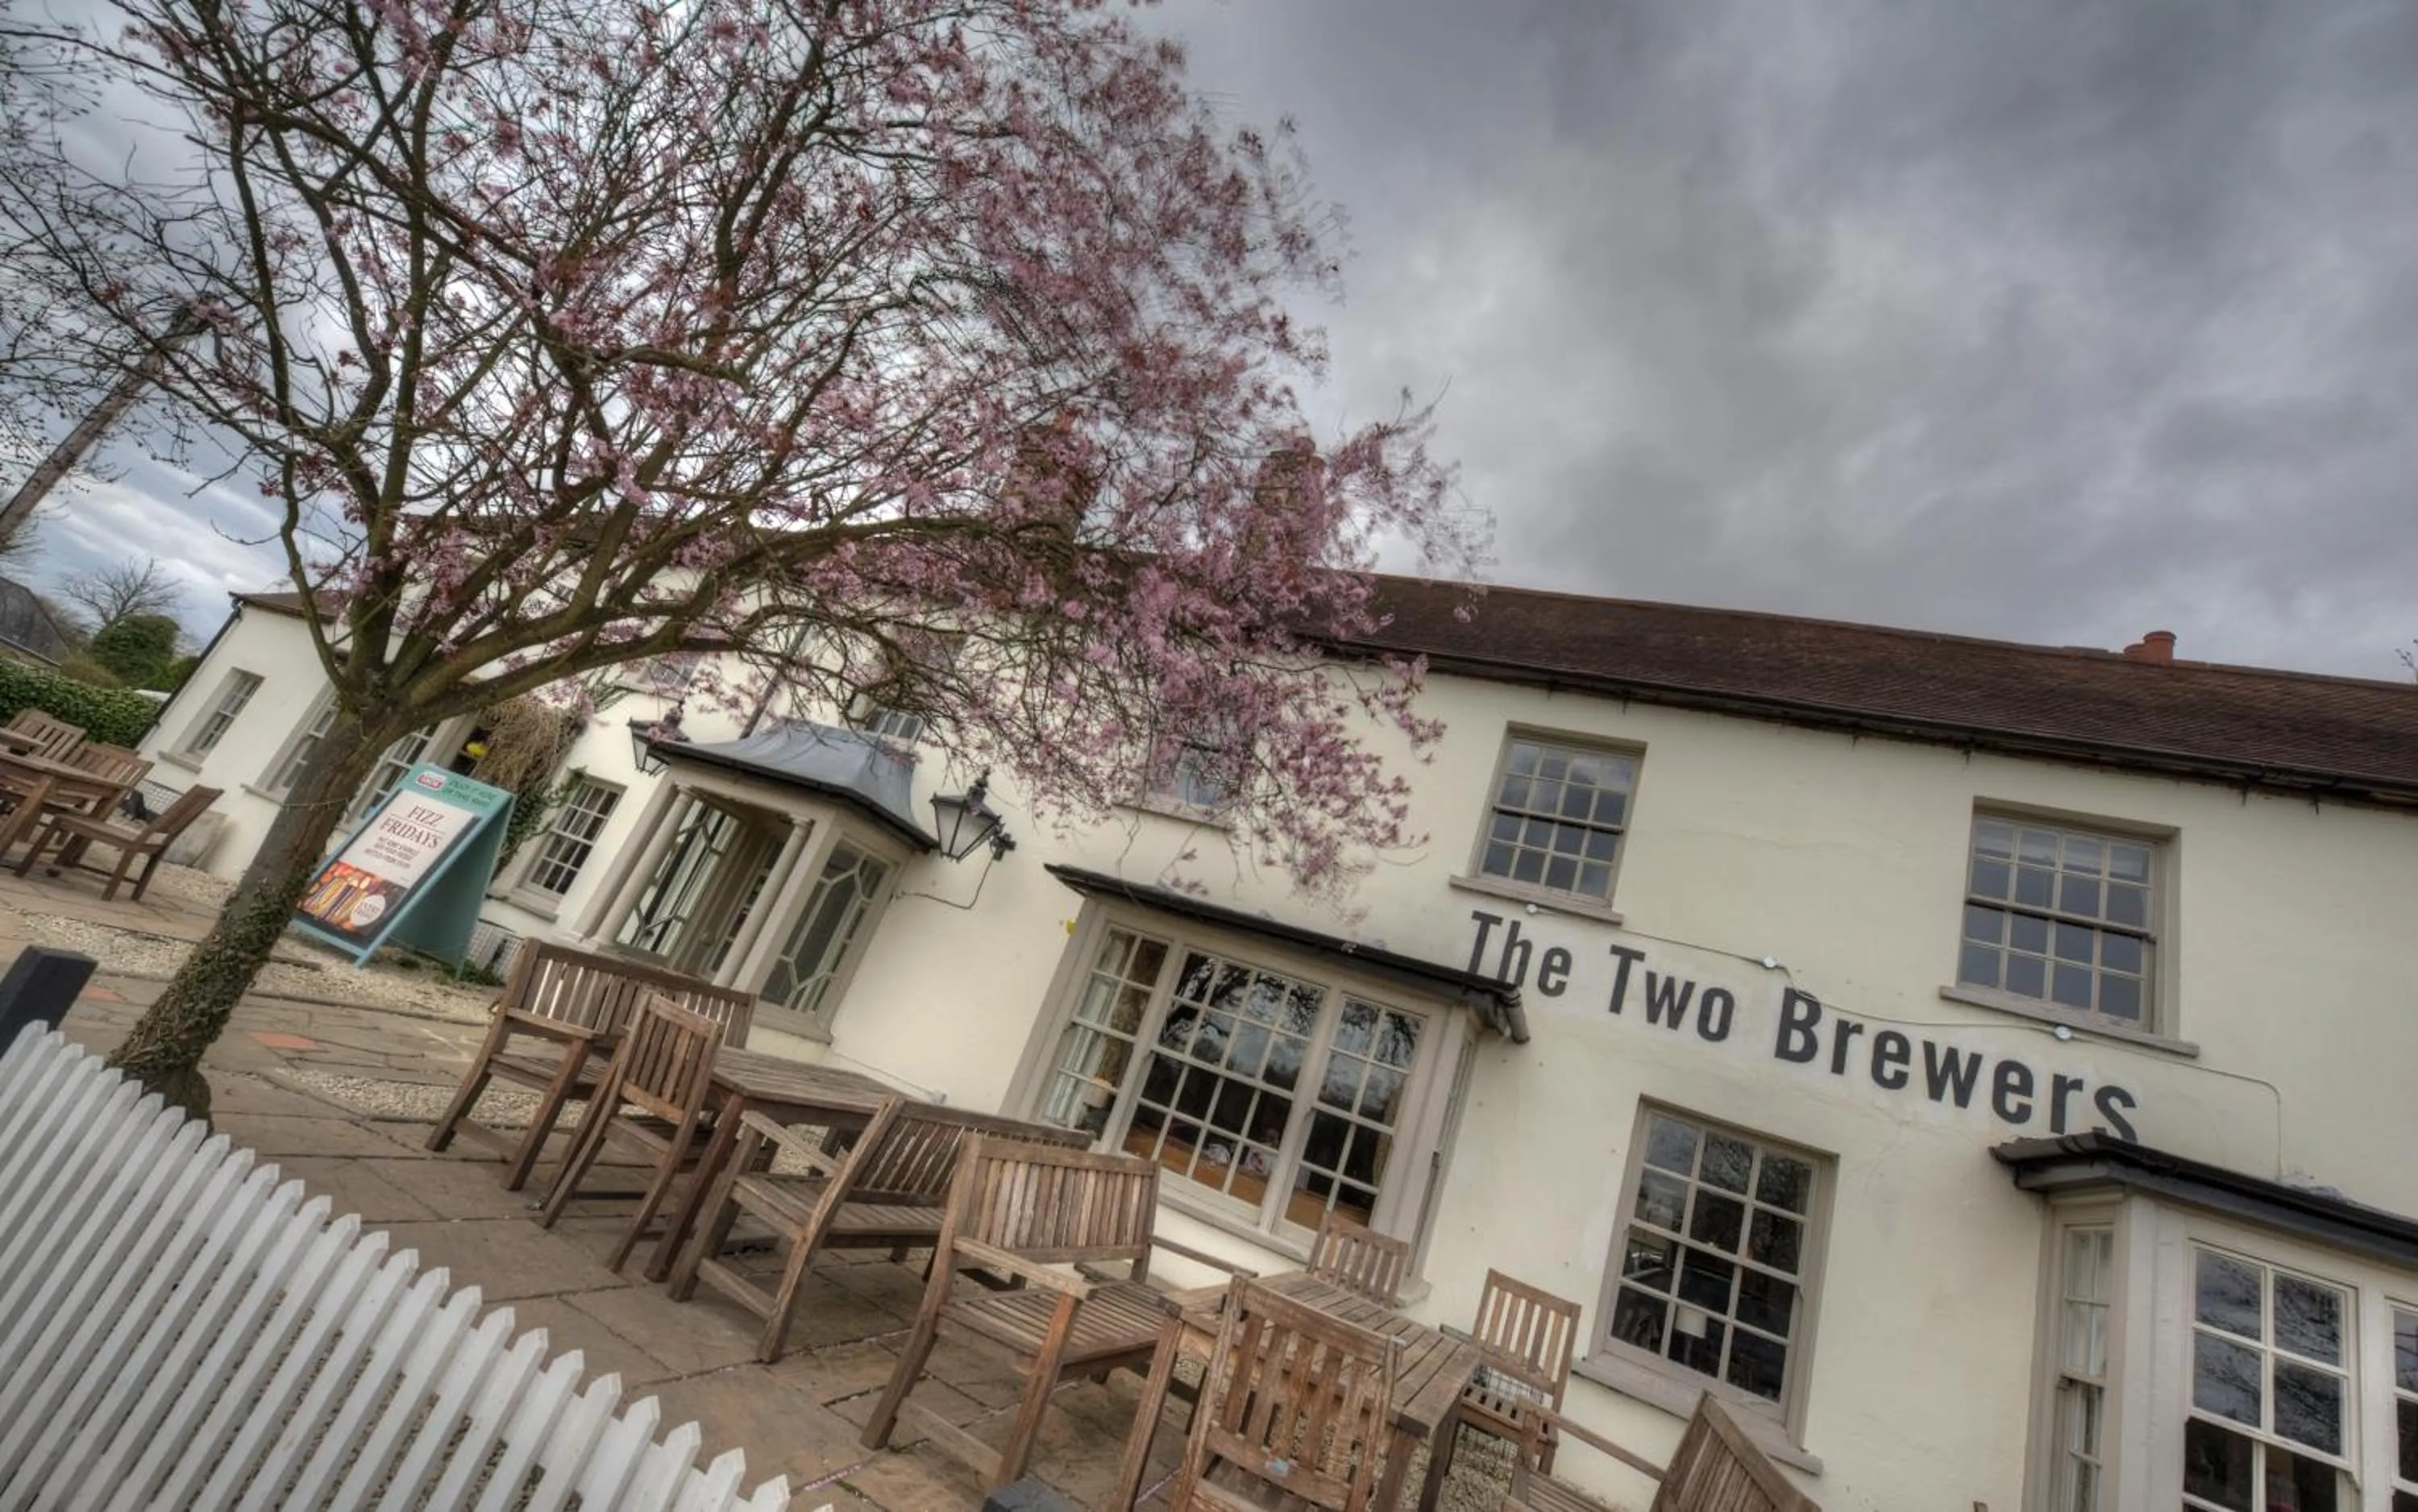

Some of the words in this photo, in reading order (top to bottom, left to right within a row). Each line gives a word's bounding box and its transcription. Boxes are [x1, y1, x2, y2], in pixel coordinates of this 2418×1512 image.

[380, 816, 441, 849] FRIDAYS
[407, 805, 445, 827] FIZZ
[1468, 910, 1573, 997] The
[1609, 944, 1735, 1042] Two
[1775, 987, 2138, 1145] Brewers
